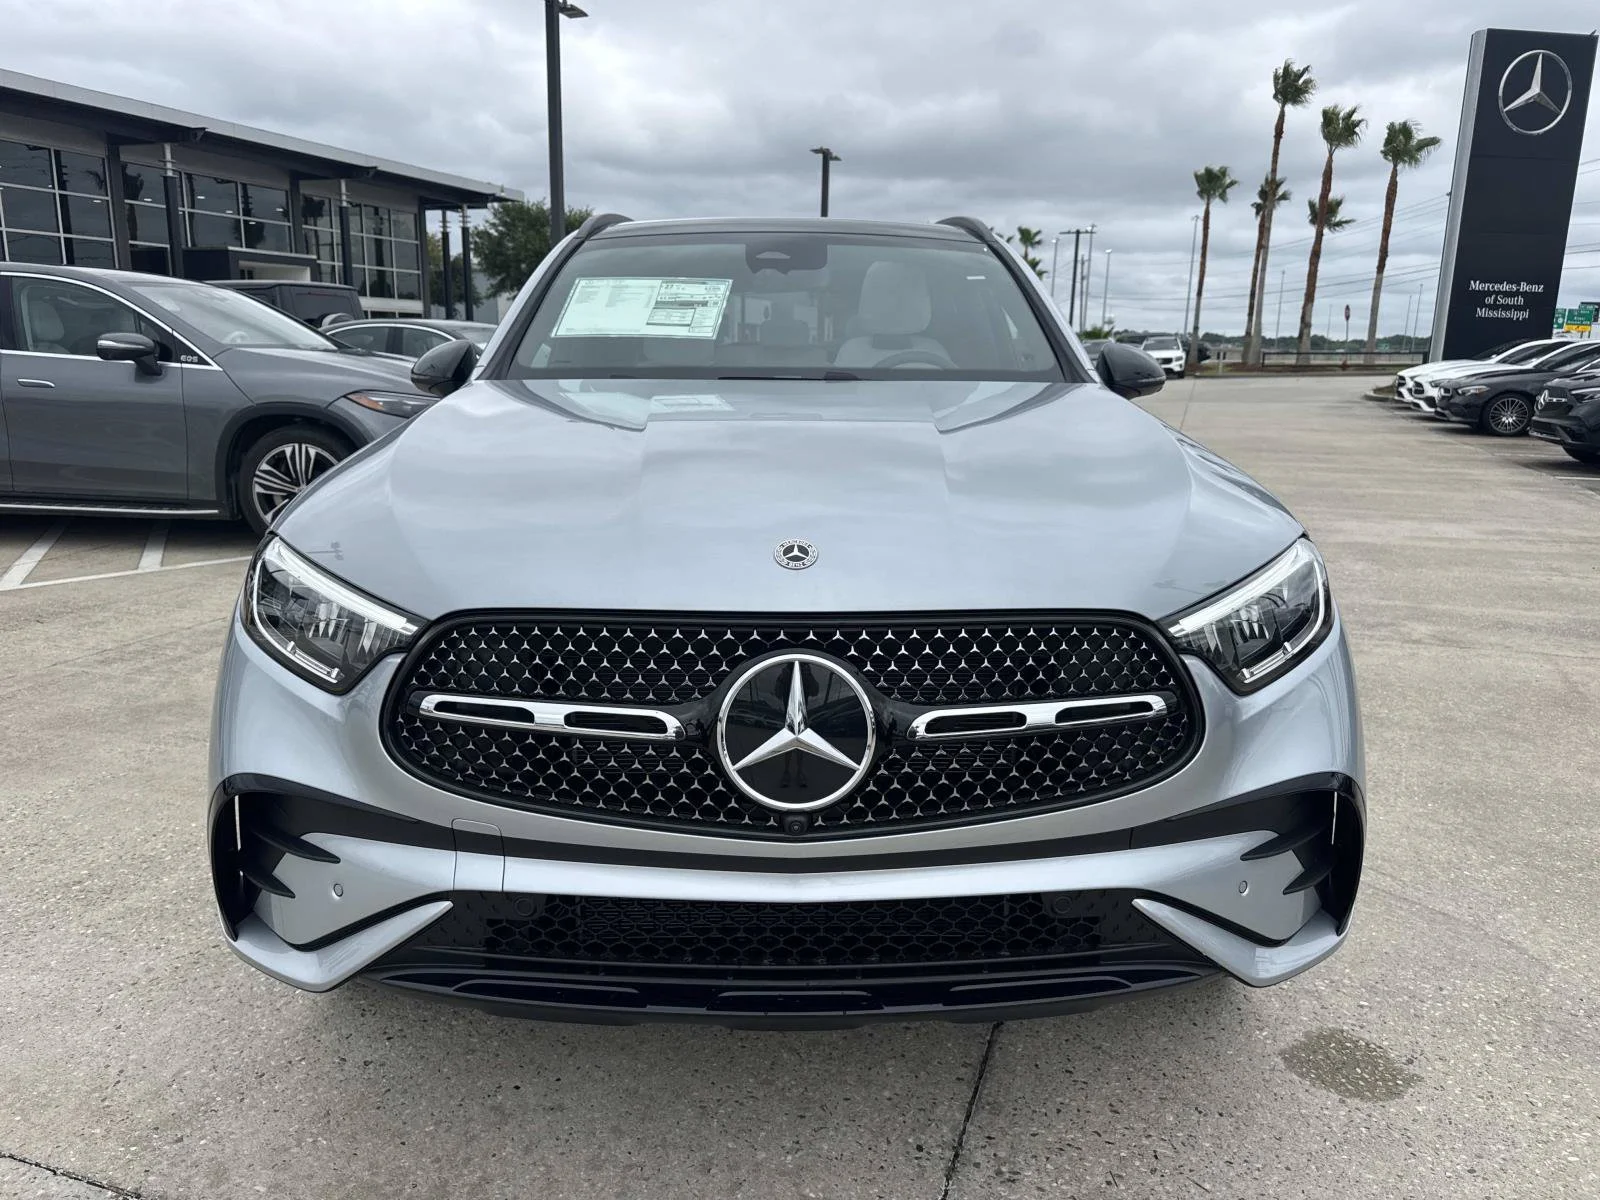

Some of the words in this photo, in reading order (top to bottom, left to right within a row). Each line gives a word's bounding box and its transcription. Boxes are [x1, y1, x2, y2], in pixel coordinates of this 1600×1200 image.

[1469, 280, 1544, 292] Mercedes-Benz
[1485, 294, 1495, 305] of
[1496, 294, 1524, 305] South
[1476, 307, 1529, 320] Mississippi
